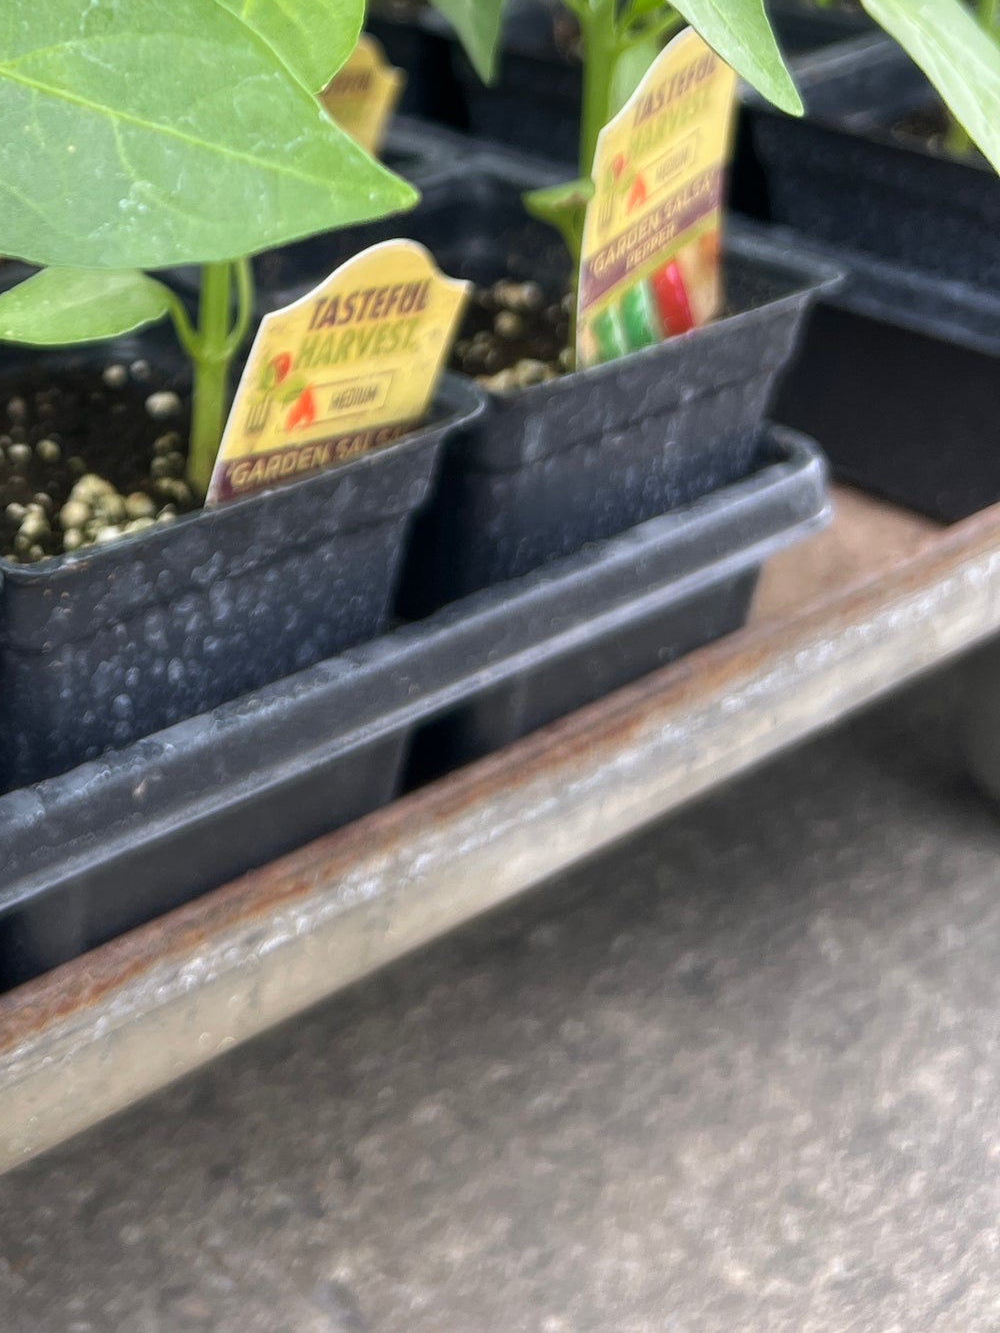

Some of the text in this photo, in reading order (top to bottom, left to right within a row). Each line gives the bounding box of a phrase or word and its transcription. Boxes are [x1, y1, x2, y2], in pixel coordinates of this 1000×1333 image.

[625, 223, 676, 272] PEPPER
[308, 281, 430, 331] TASTEFUL
[297, 319, 420, 369] HARVEST
[330, 384, 379, 411] MEDIUM
